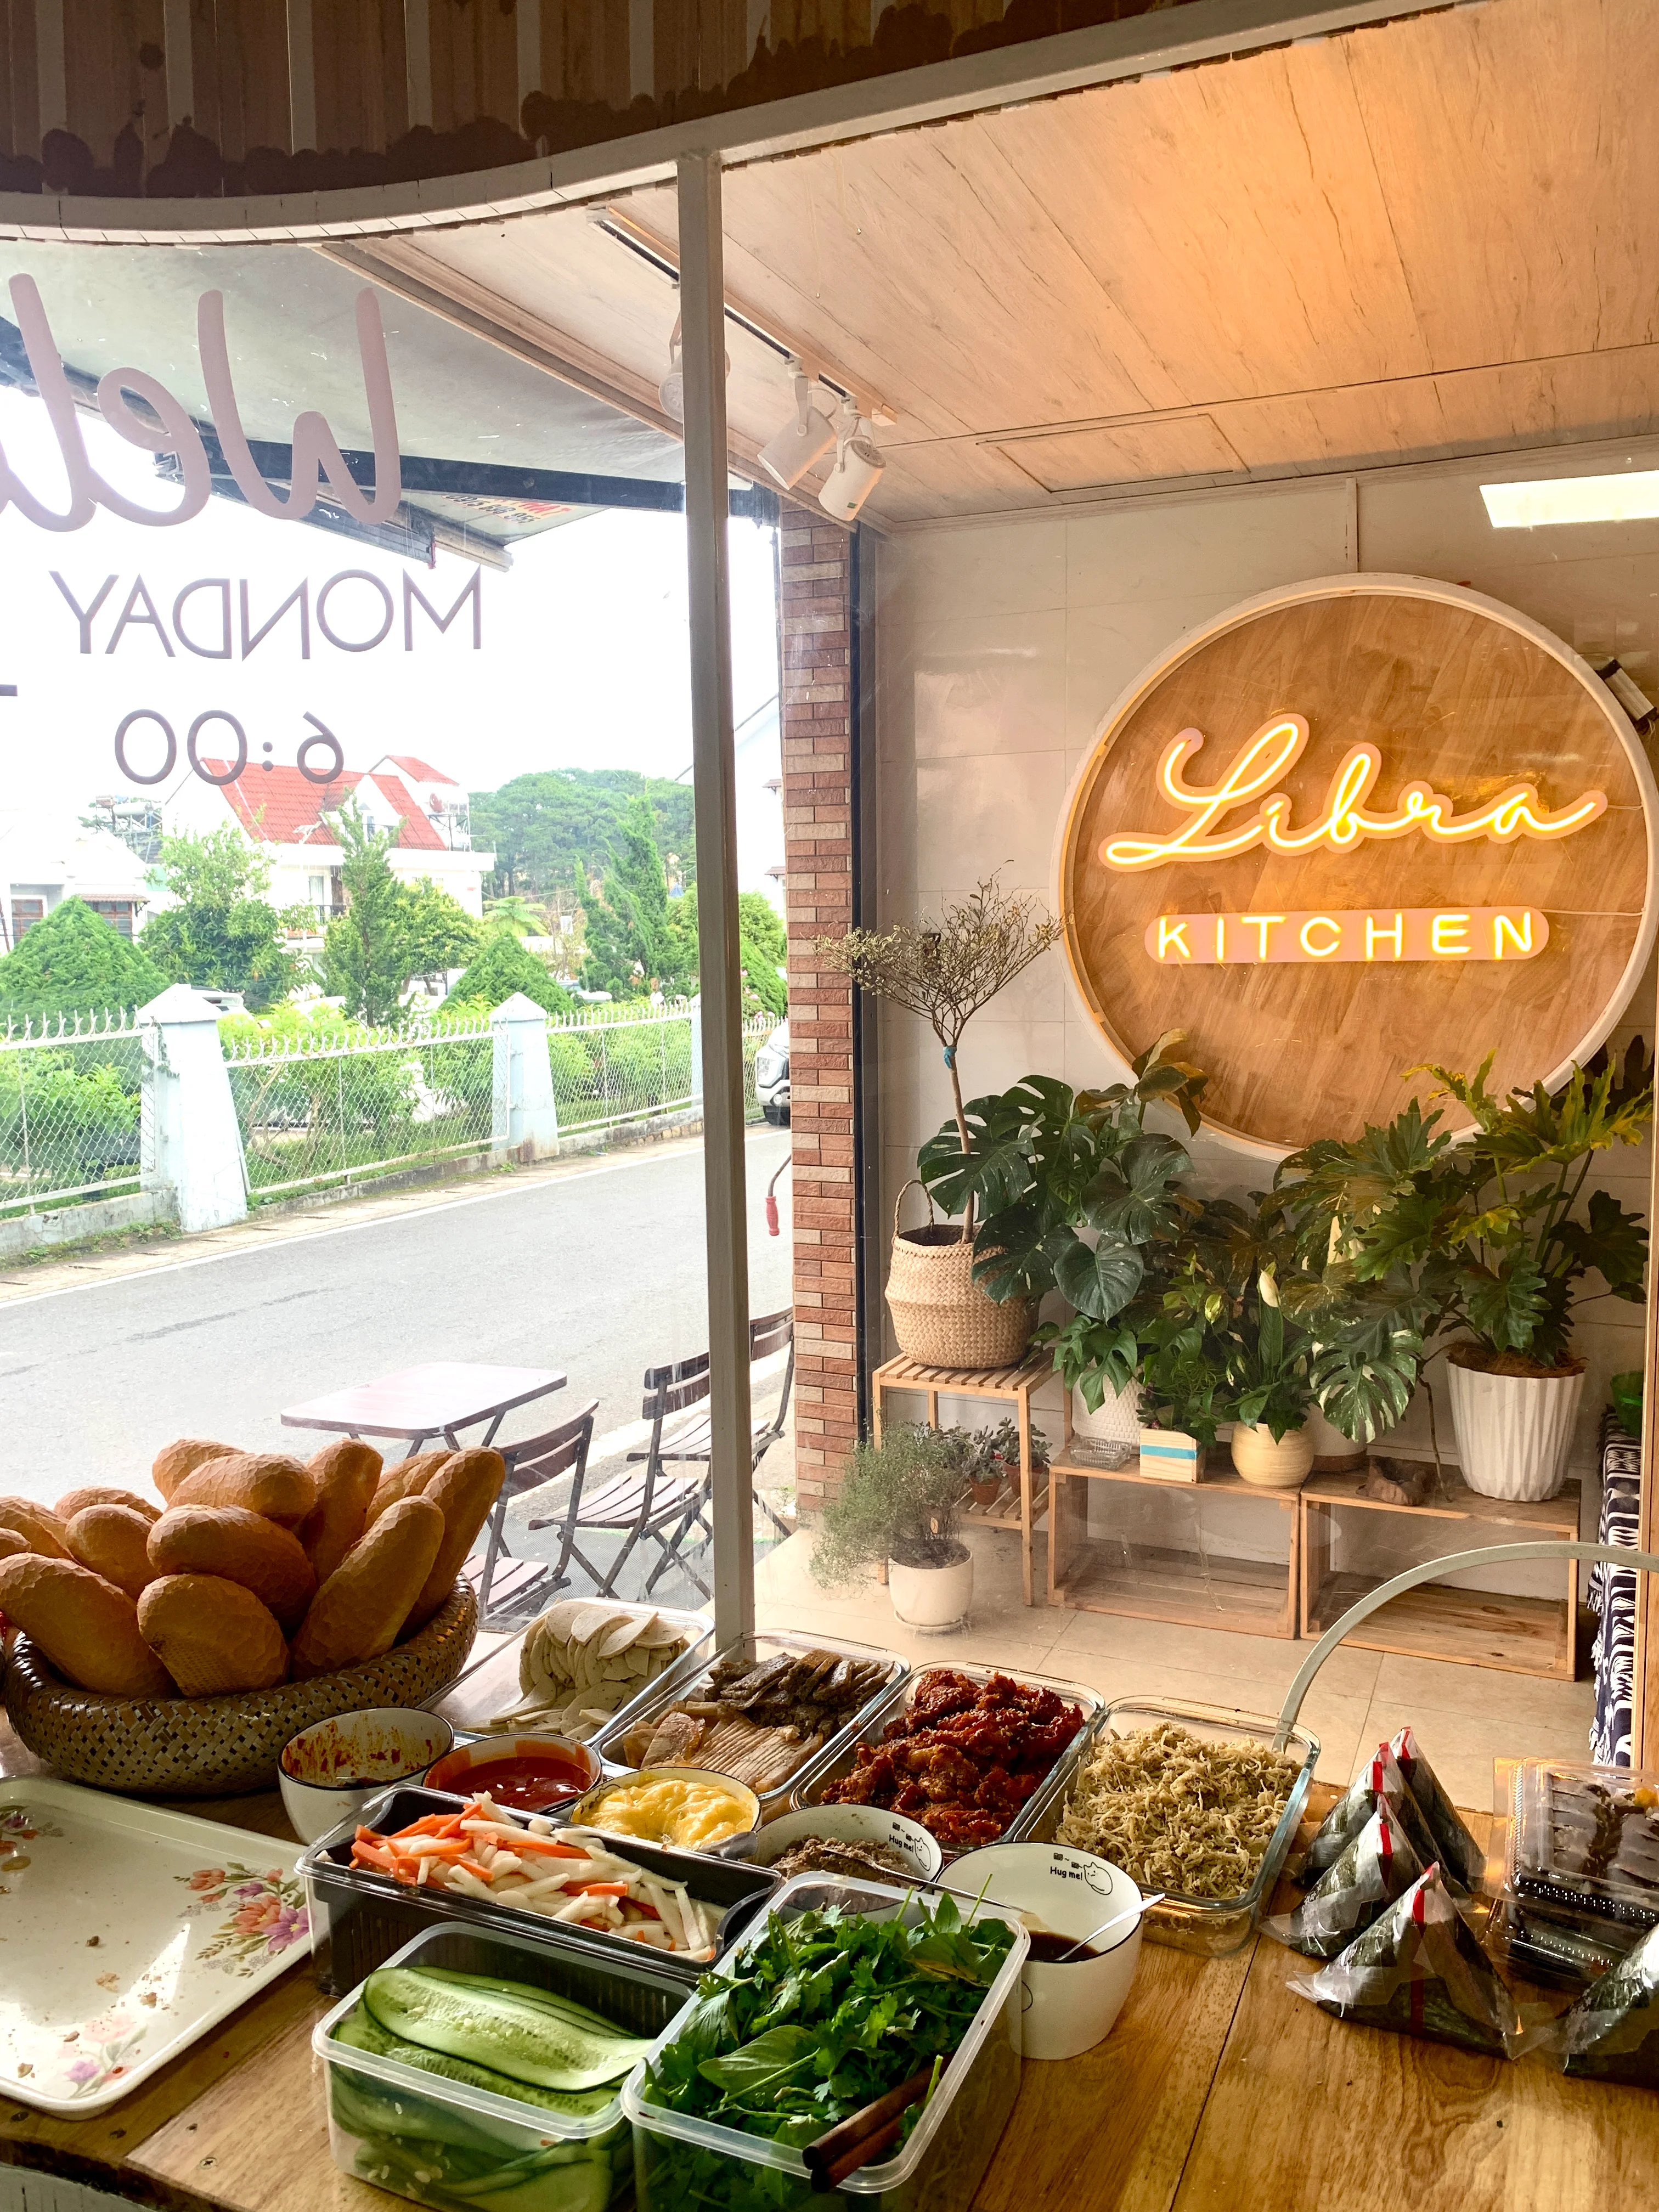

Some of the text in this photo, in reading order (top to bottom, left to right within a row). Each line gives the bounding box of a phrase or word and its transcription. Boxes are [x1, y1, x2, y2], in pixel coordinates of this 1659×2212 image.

[1105, 720, 1598, 866] Libra
[1156, 912, 1534, 962] KITCHEN
[889, 1834, 914, 1853] Hug me!
[1050, 1866, 1082, 1881] Hug me!
